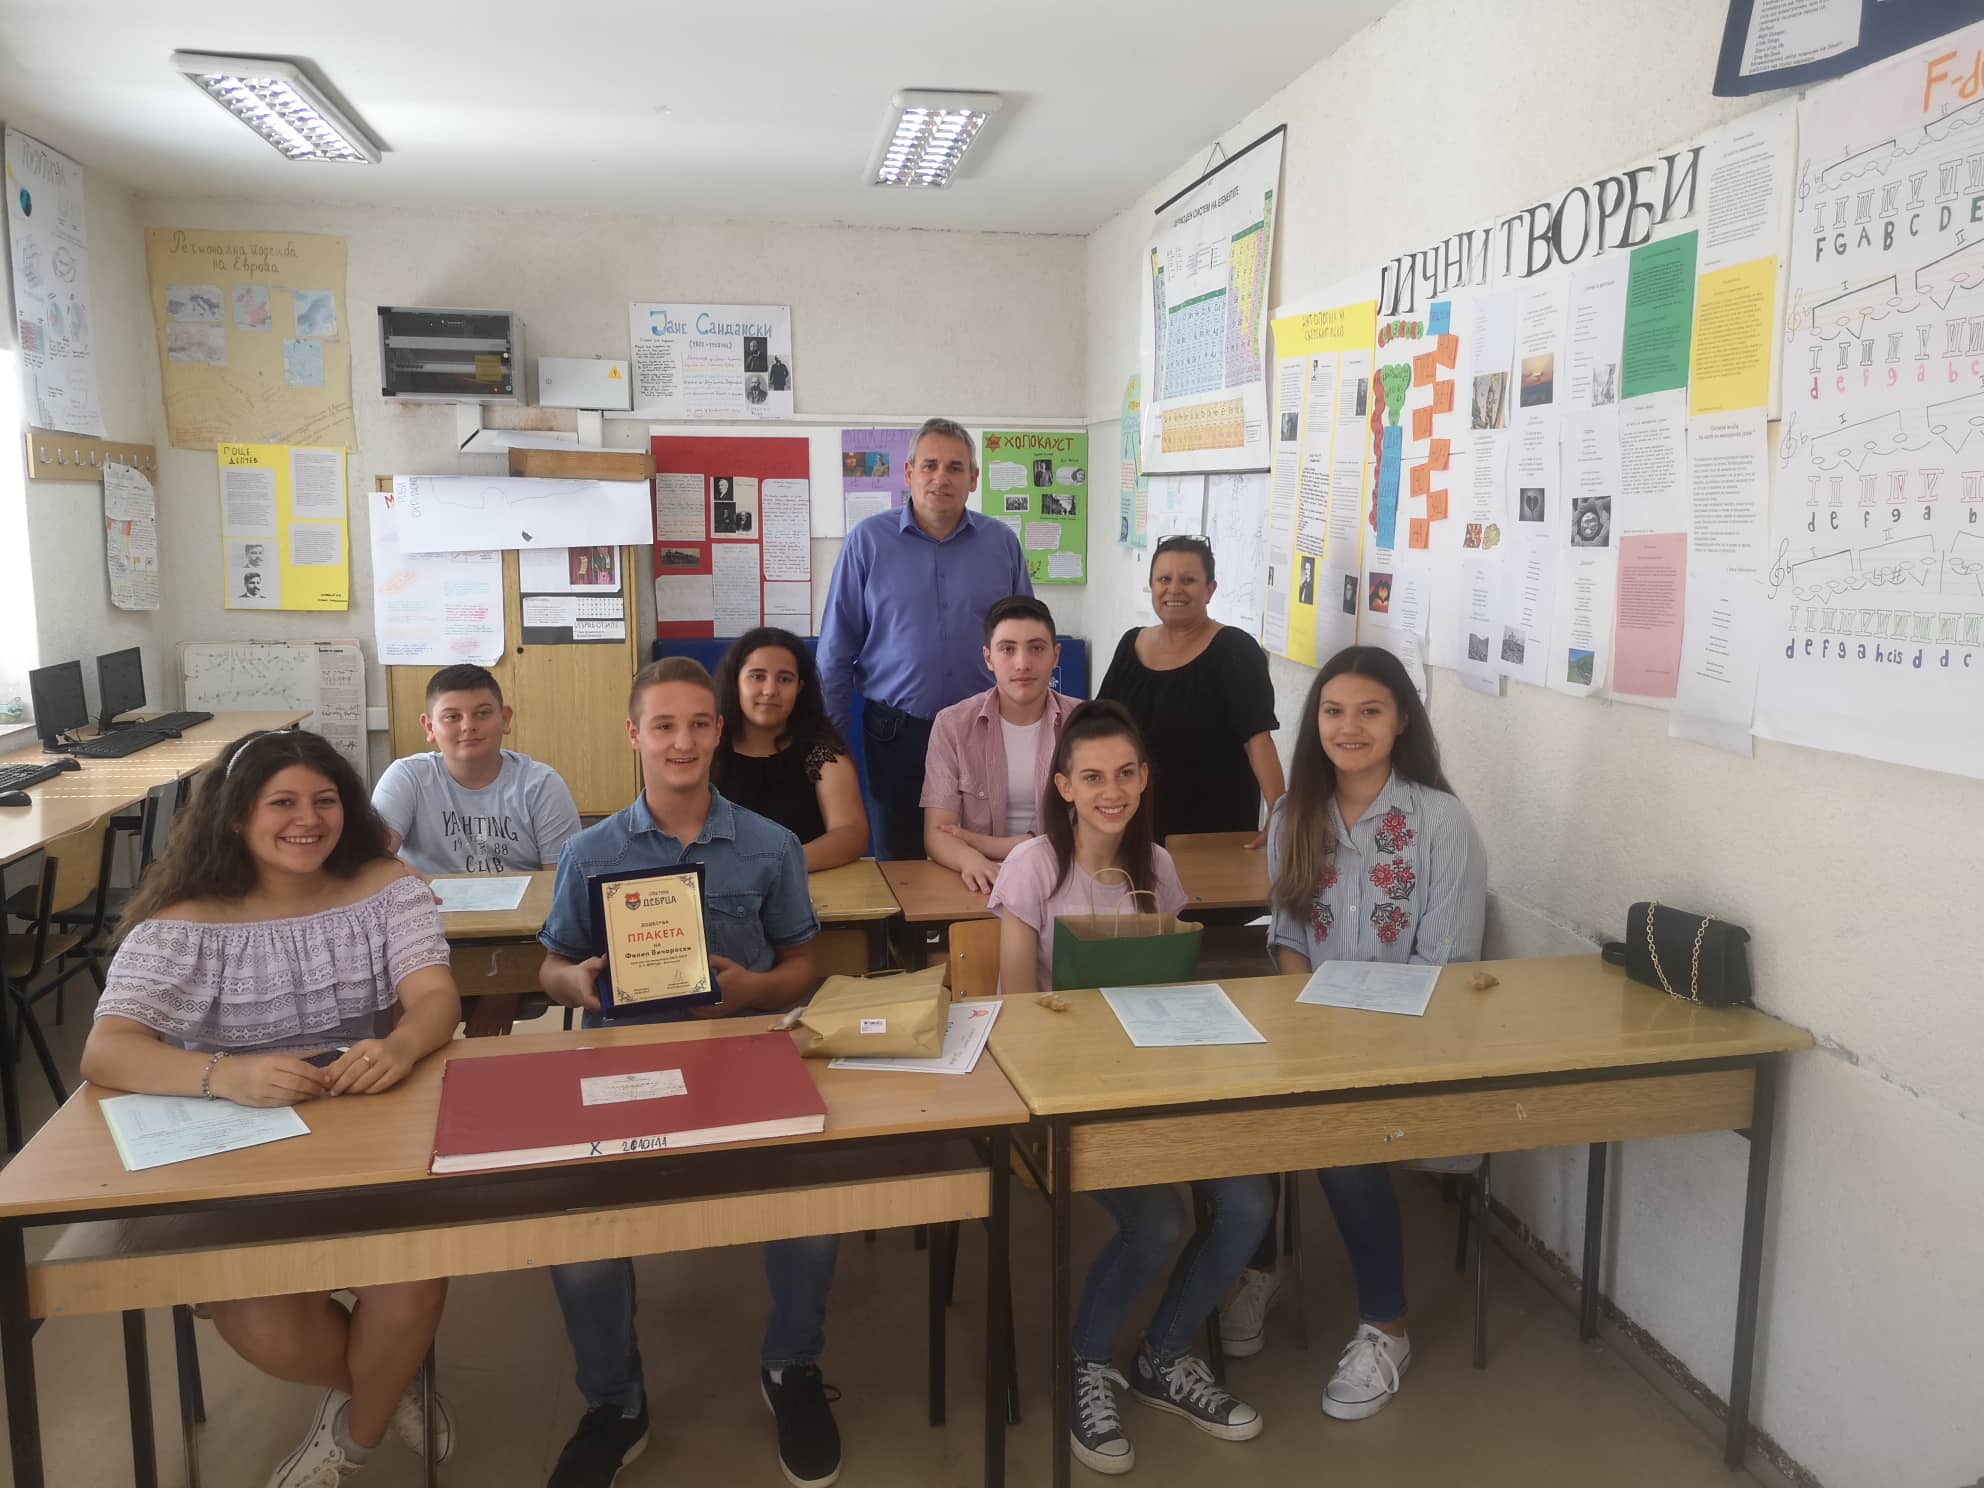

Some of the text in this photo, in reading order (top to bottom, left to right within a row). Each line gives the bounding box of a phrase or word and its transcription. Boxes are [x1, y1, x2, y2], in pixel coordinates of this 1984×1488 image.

[1376, 227, 1495, 317] ЛИЧНИ
[1499, 146, 1705, 279] ТВОРБИ
[1815, 195, 1984, 262] F G A B C D E
[695, 312, 773, 338] Сандански
[1810, 376, 1819, 400] d
[1836, 375, 1845, 393] e
[1887, 367, 1897, 387] g
[1948, 360, 1958, 383] b
[224, 447, 252, 456] ГОЦЕ
[1004, 435, 1074, 451] ХОЛОКАУСТ
[1807, 505, 1977, 533] d e f g a b
[1786, 638, 1972, 668] d e f g a h cis d d c
[494, 843, 509, 855] 88
[643, 896, 677, 907] ДЕБРЦА
[627, 928, 684, 943] ПЛАКЕТА
